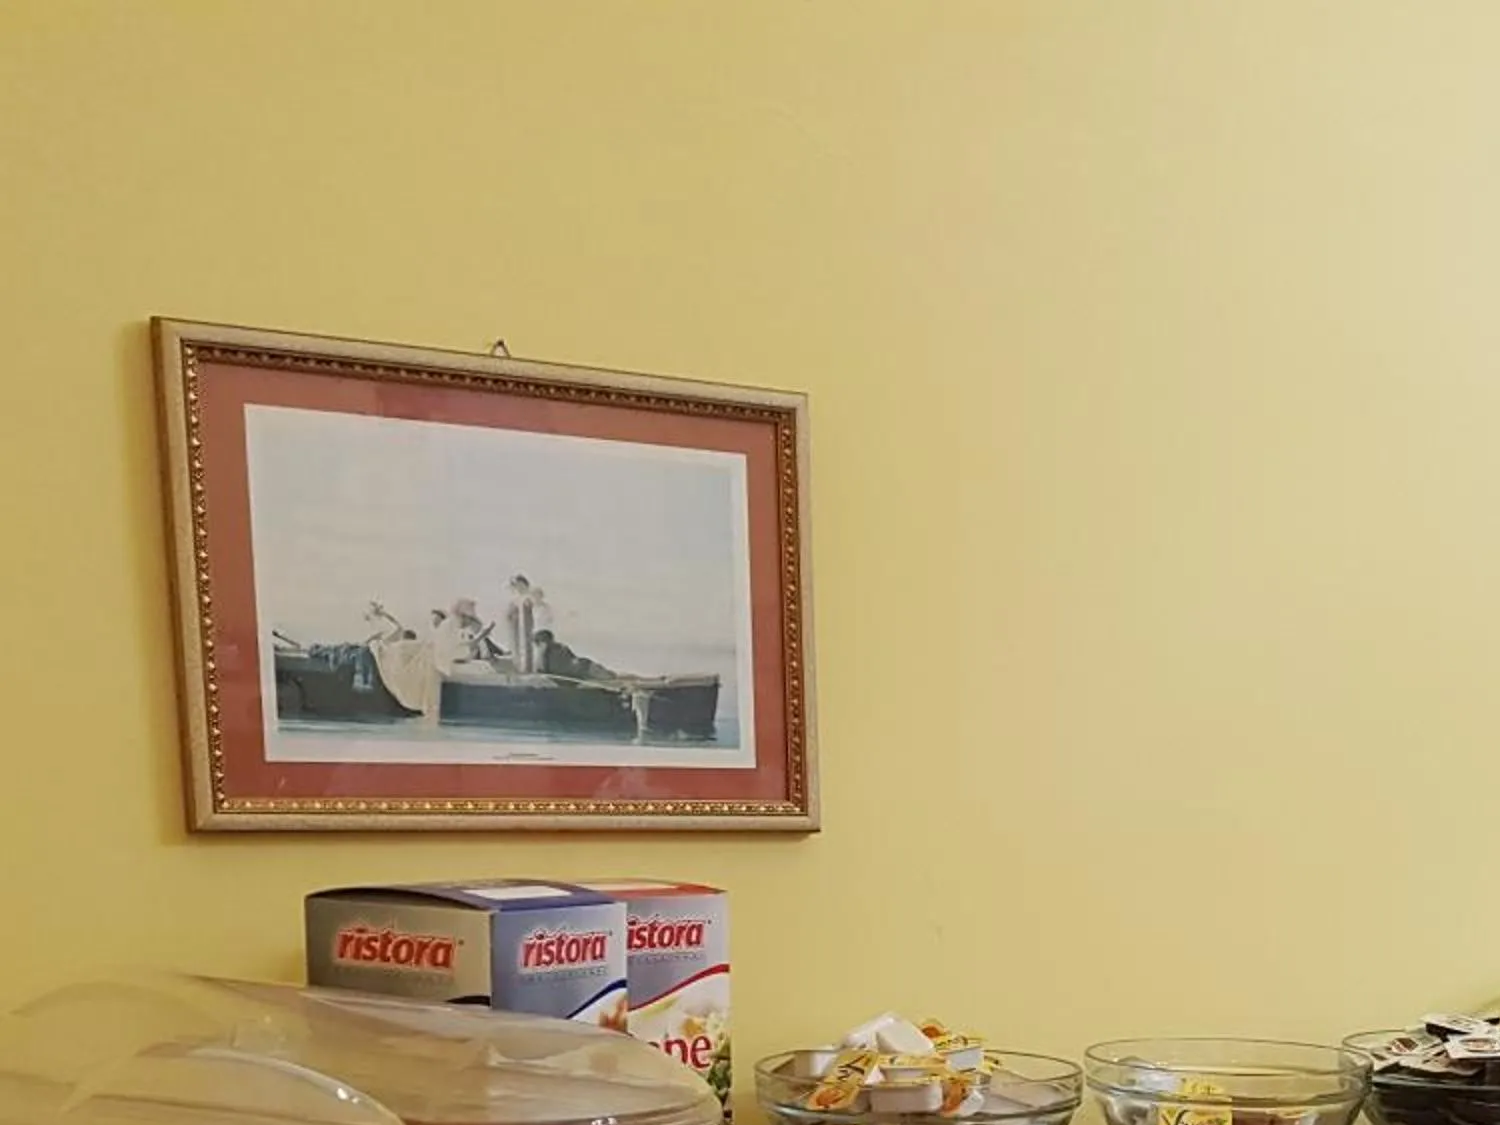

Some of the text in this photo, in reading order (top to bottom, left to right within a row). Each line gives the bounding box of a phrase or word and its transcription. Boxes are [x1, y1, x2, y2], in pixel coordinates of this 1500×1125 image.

[337, 928, 453, 969] ristora
[521, 929, 607, 968] ristora
[627, 919, 703, 951] istora
